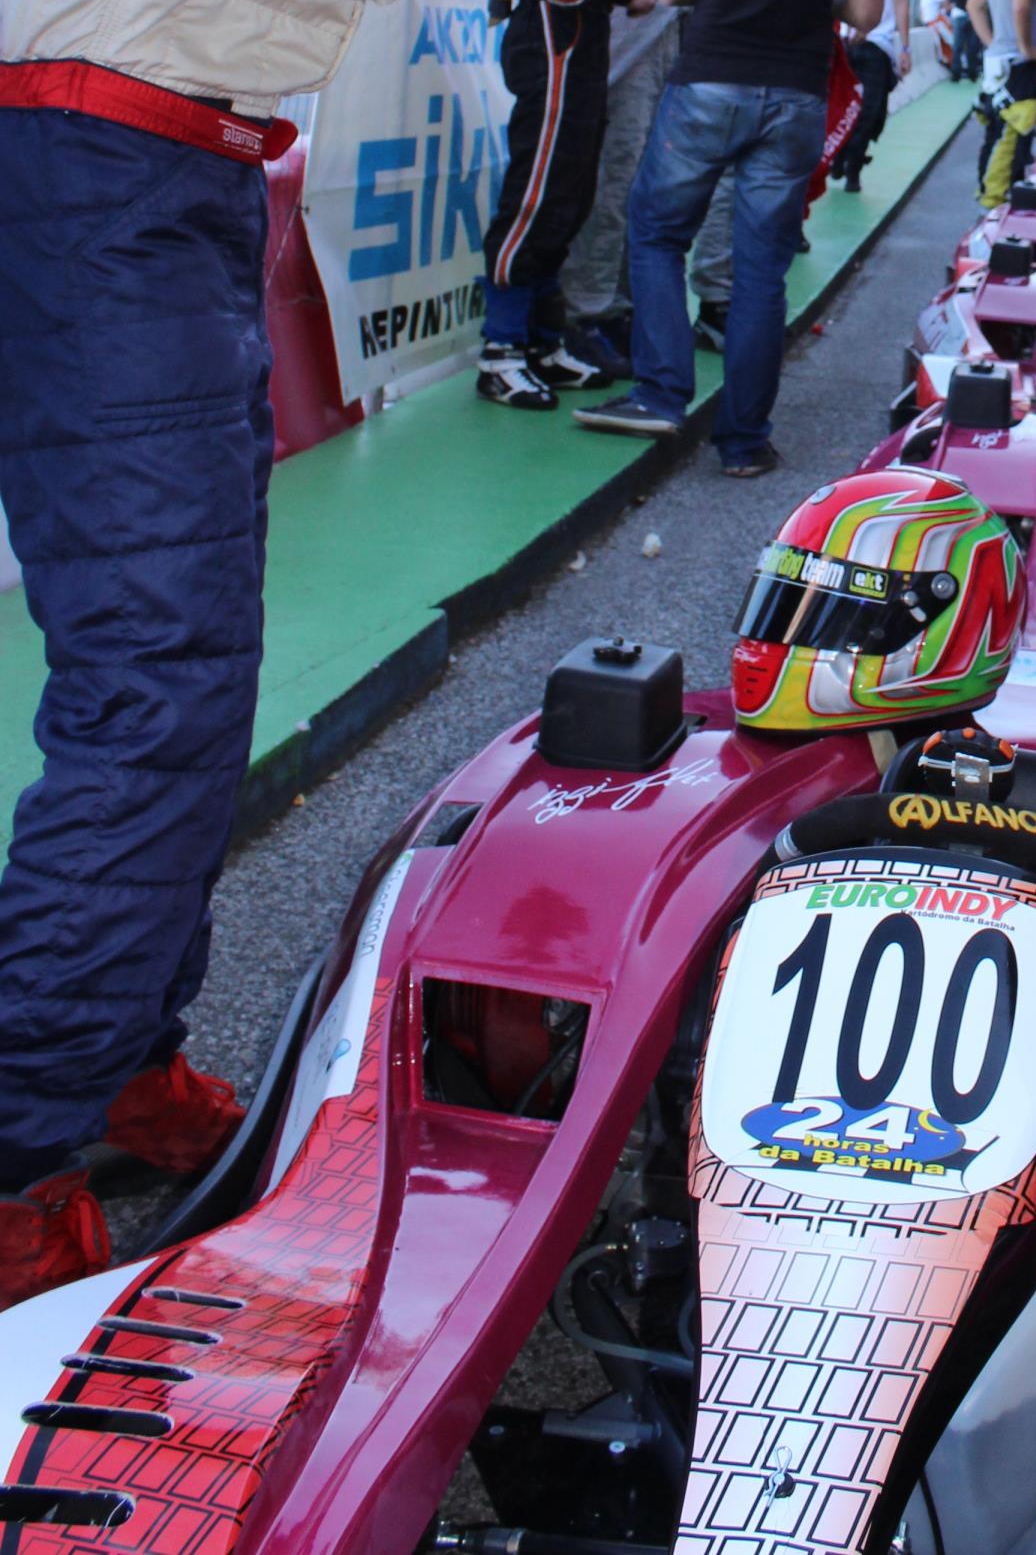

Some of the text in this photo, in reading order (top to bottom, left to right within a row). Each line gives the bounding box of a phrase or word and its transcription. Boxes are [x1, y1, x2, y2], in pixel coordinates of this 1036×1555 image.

[806, 883, 1018, 921] EUROINDY
[900, 908, 1016, 932] Kartódromo da Batalha
[771, 906, 1019, 1125] 100
[772, 1098, 916, 1150] 24
[758, 1145, 945, 1176] da Batalha
[802, 1133, 890, 1154] horas
